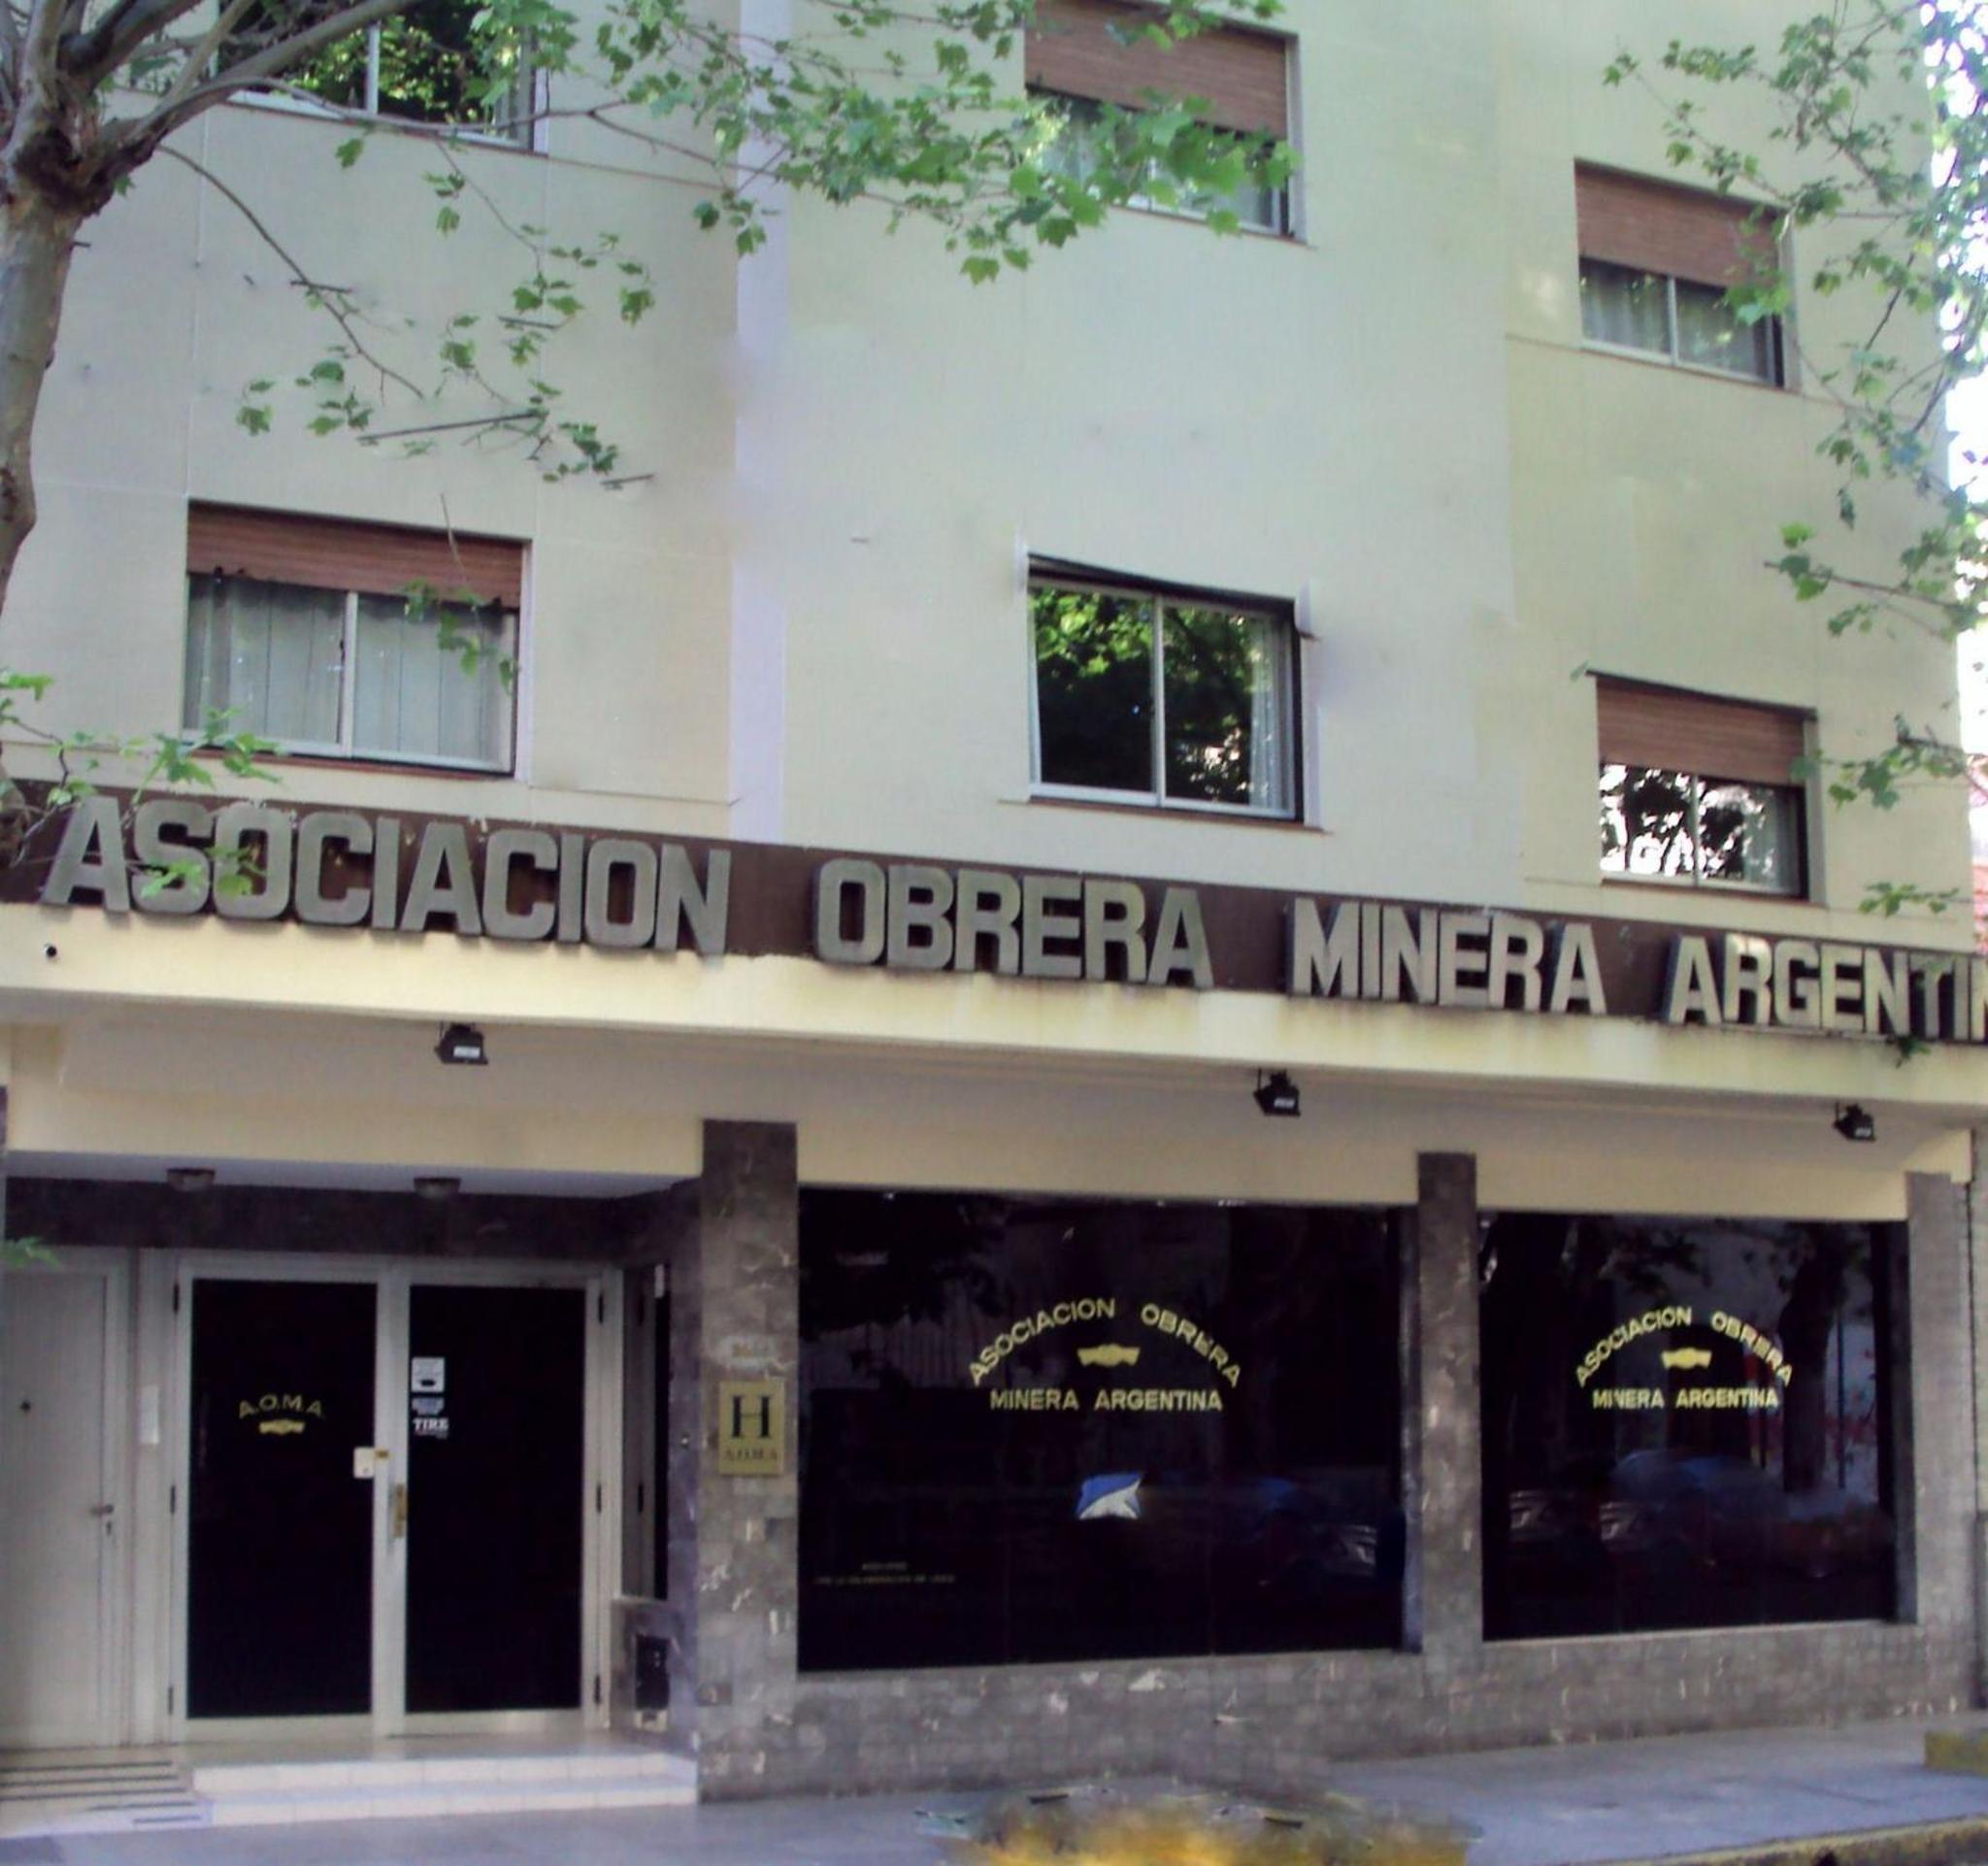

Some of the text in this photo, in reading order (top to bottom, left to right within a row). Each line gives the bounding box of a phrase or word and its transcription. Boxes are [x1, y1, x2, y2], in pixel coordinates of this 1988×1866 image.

[40, 795, 731, 956] ASOCIACION
[812, 857, 1214, 989] OBRERA
[1289, 896, 1607, 1016] MINERA
[969, 1298, 1242, 1388] ASOCIACION OBRERA
[1576, 1306, 1793, 1388] ASOCIACION OBRERA
[730, 1393, 772, 1440] H
[989, 1389, 1223, 1411] MINERA ARGENTINA
[1593, 1388, 1778, 1409] MINERA ARGENTINA
[413, 1417, 449, 1432] TIRE
